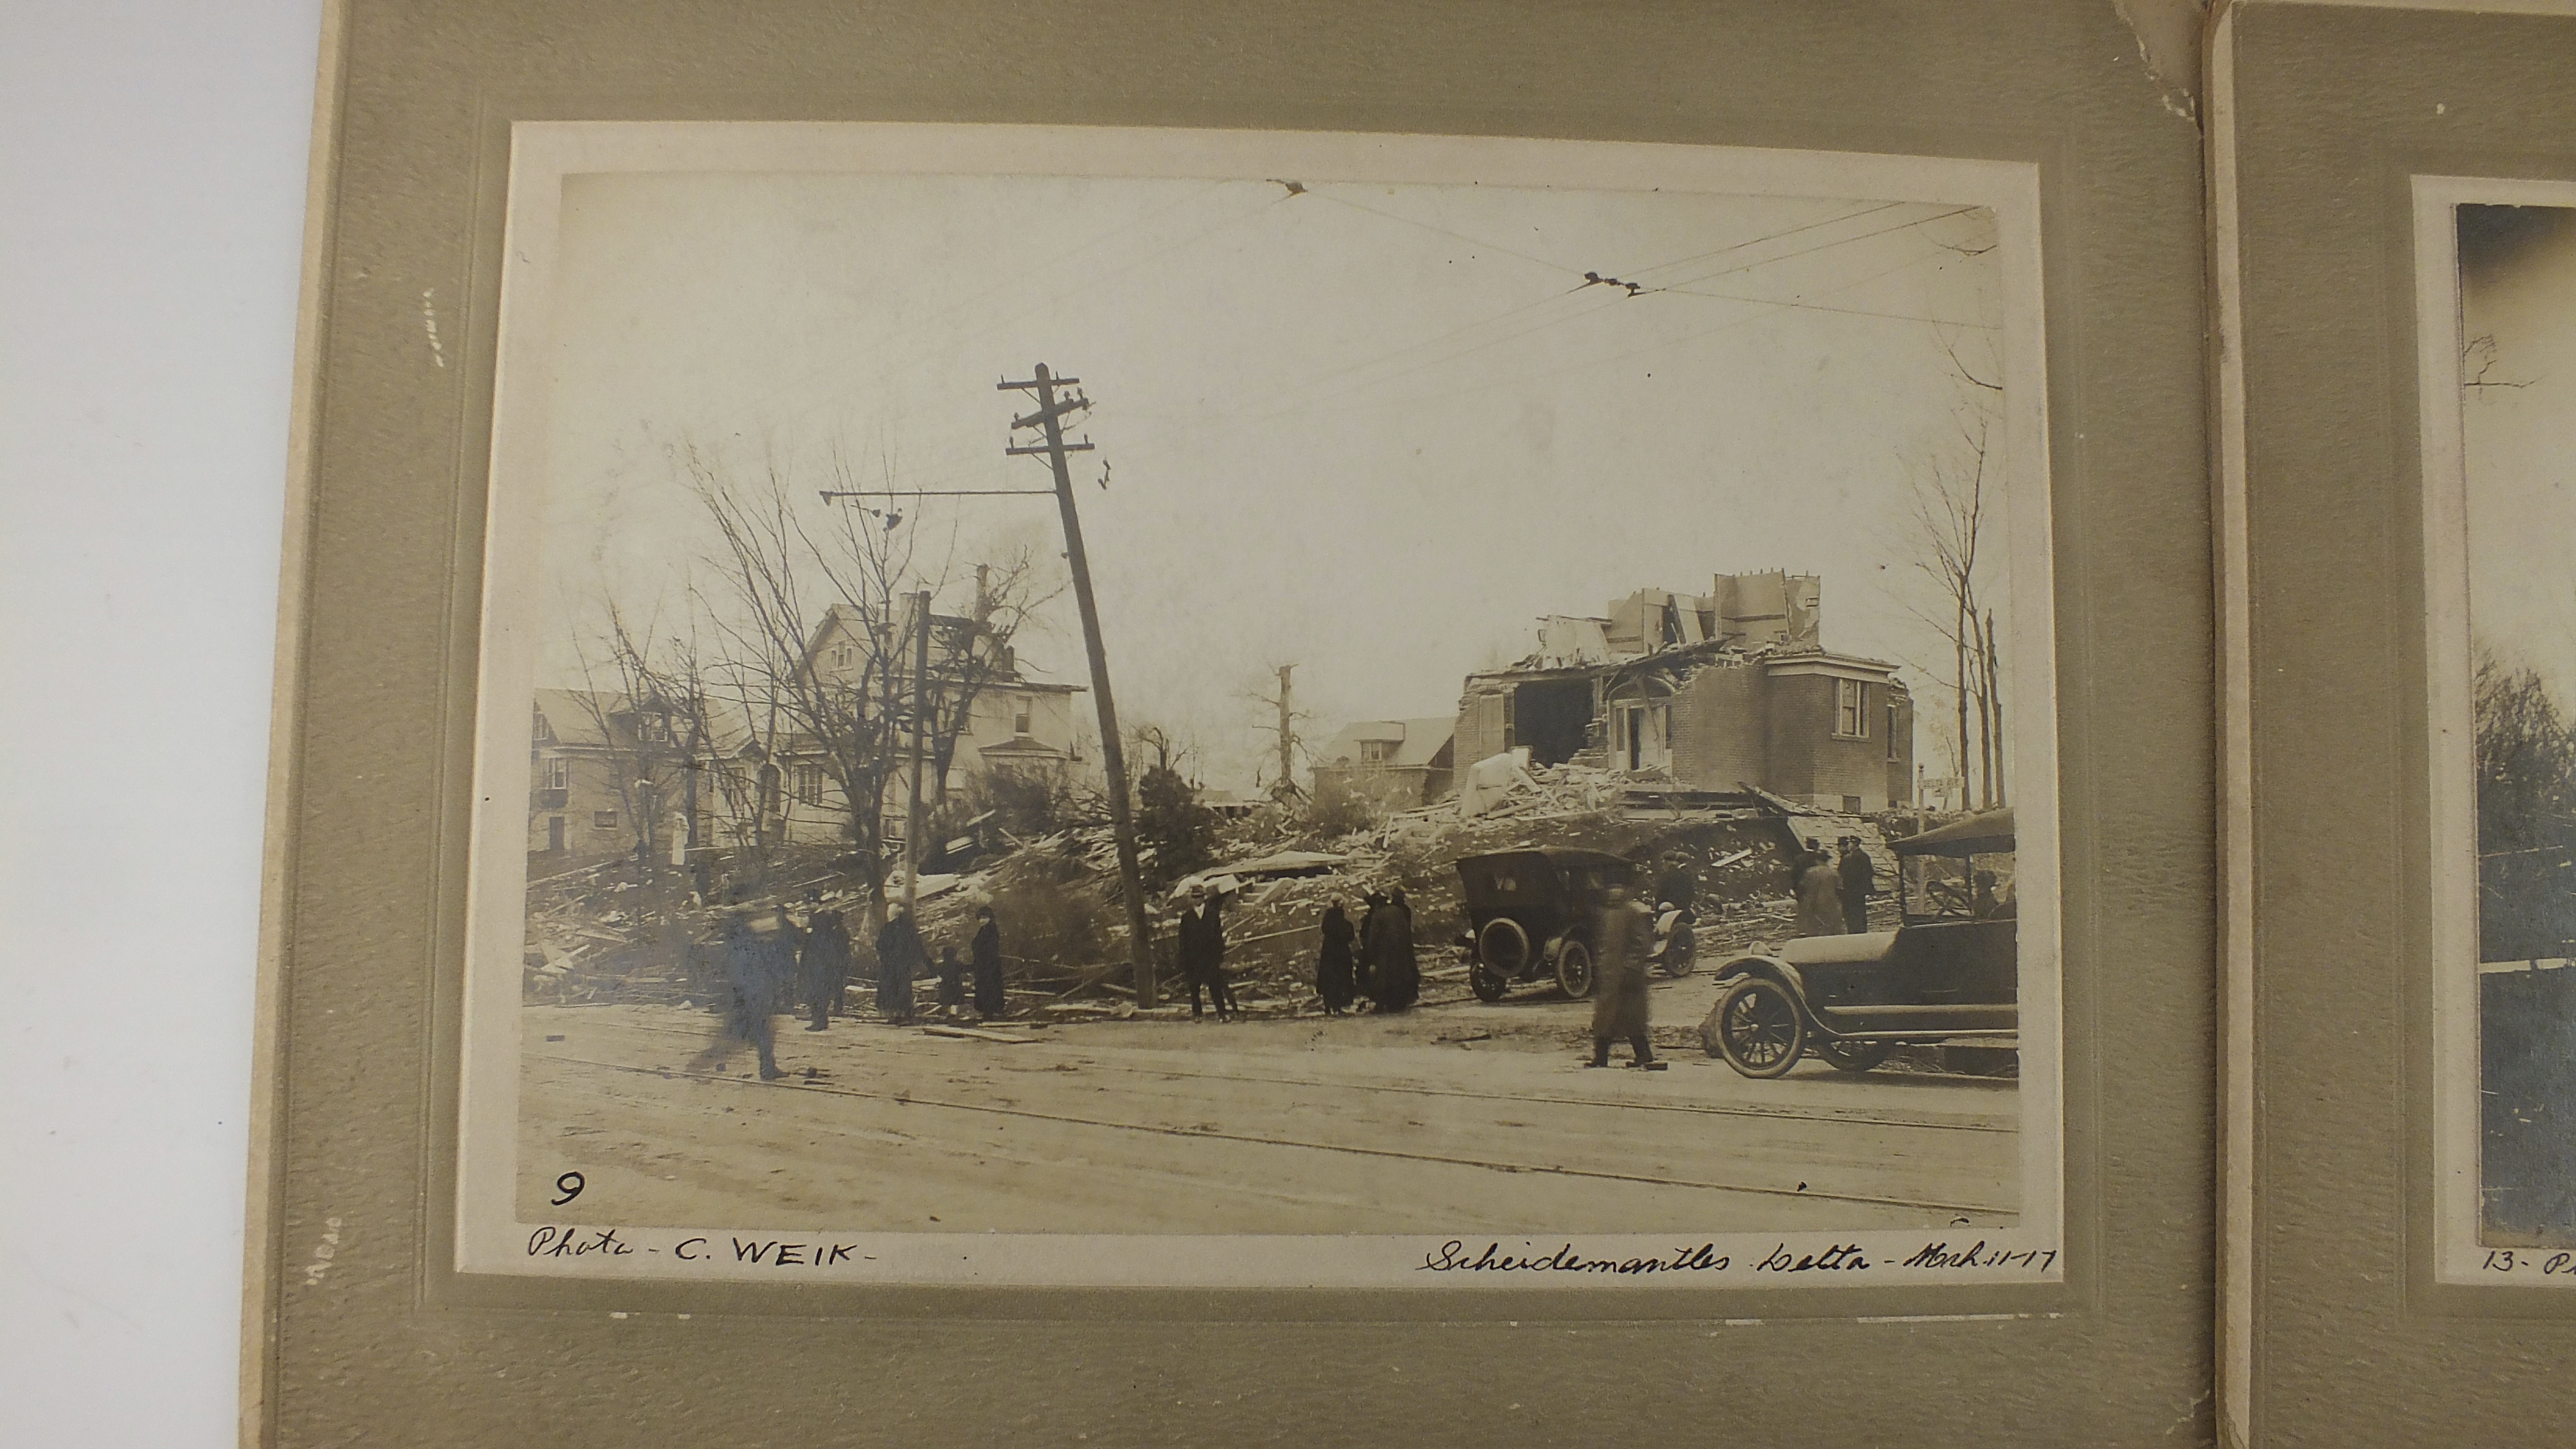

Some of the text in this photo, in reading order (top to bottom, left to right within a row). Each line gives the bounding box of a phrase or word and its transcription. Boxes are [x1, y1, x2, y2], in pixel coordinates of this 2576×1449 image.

[551, 1171, 585, 1206] 9
[675, 1237, 711, 1261] C.
[2543, 1252, 2576, 1275] P
